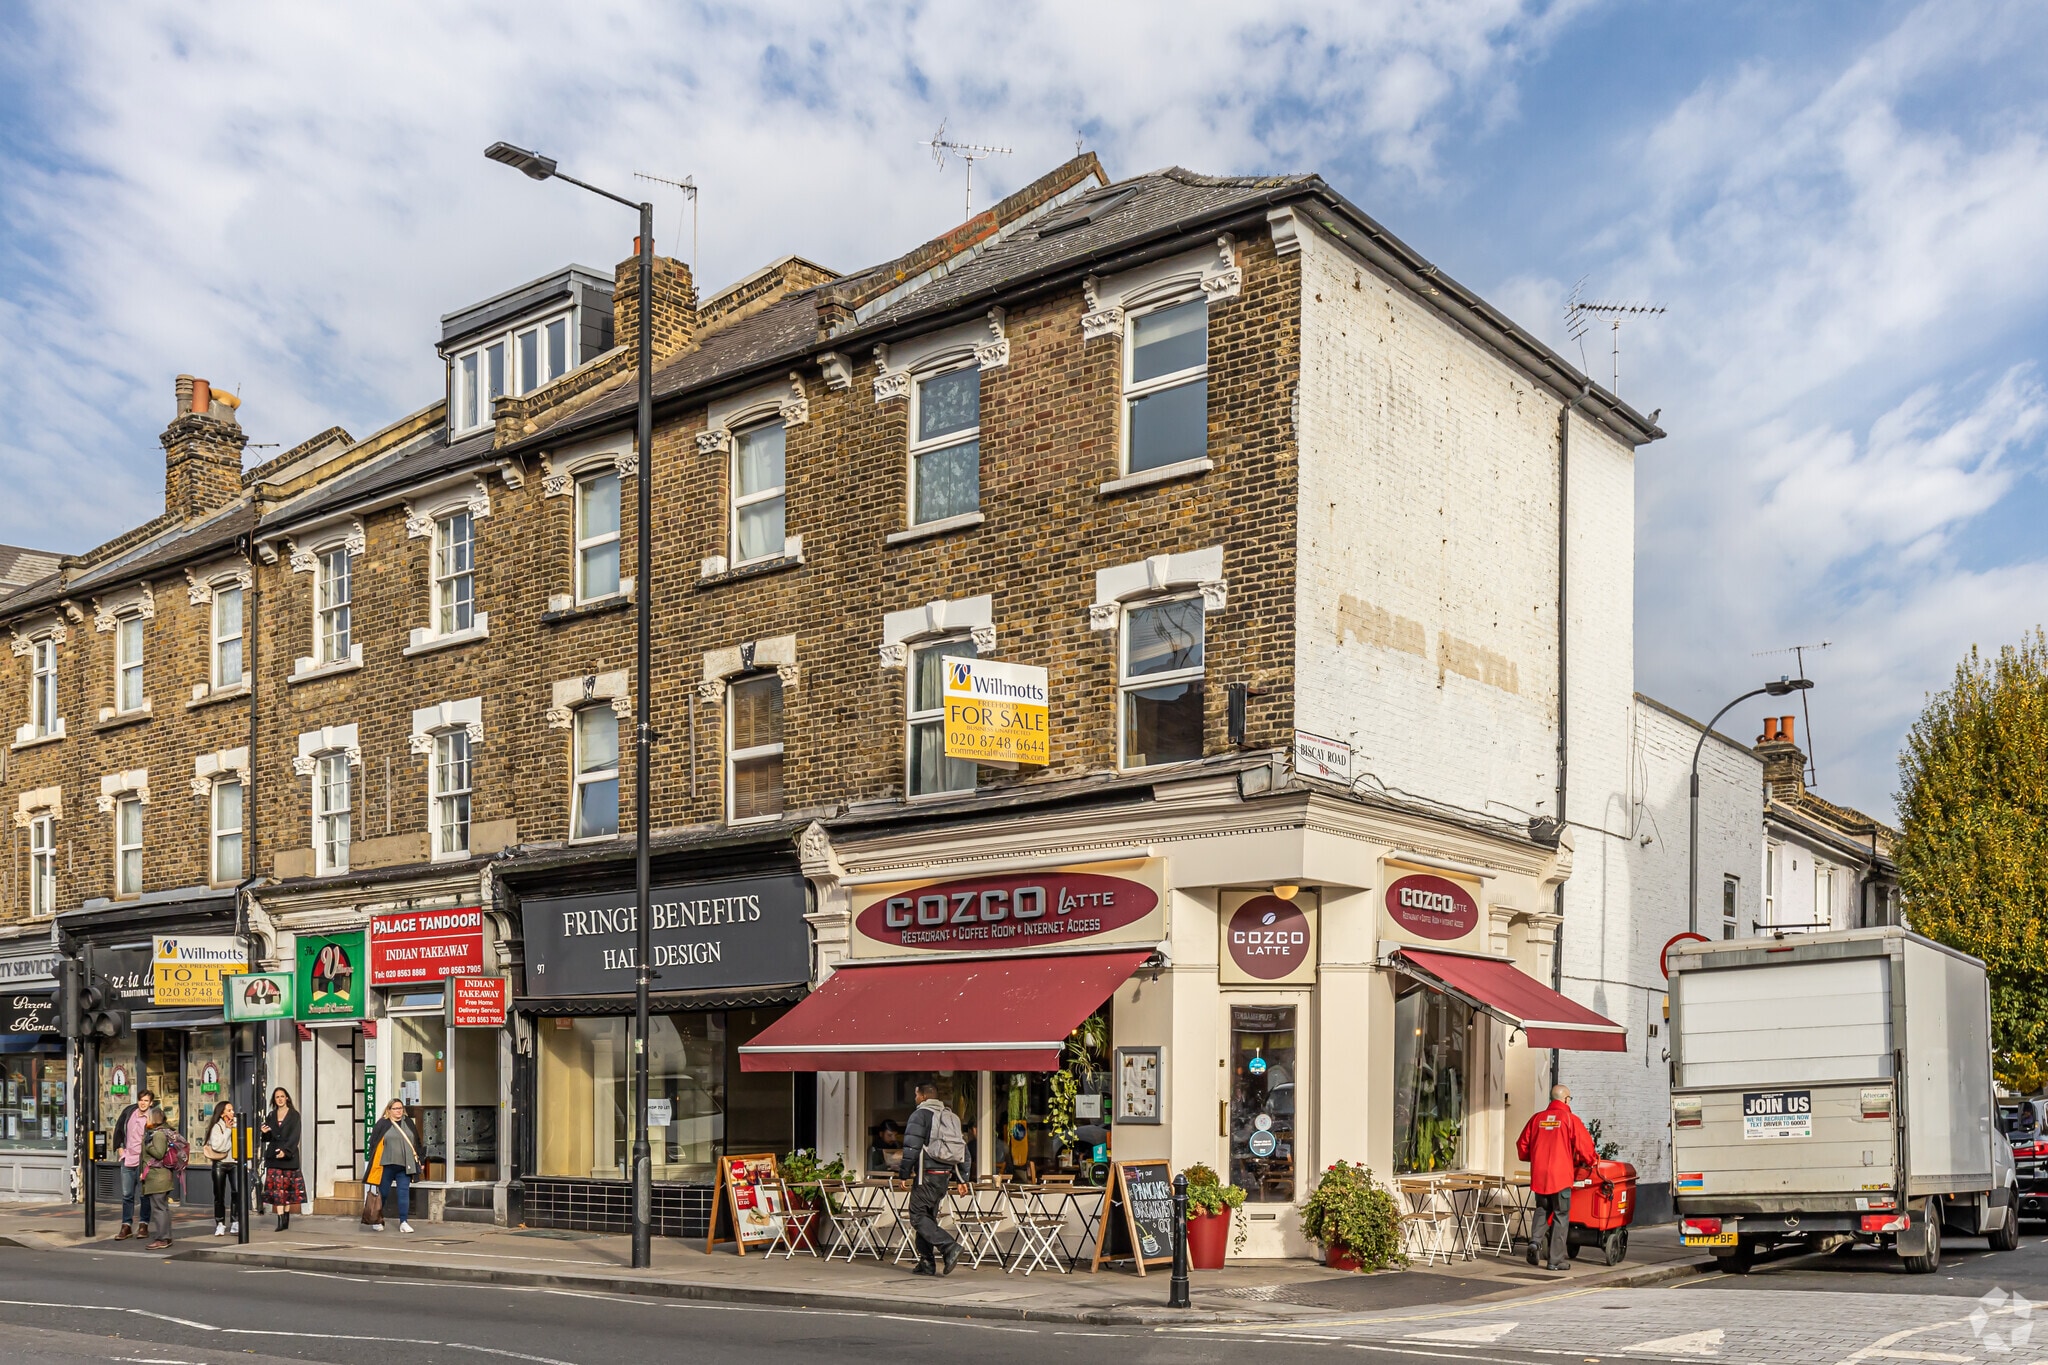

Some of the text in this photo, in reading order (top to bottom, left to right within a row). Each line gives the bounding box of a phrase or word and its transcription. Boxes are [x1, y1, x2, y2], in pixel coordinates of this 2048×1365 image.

[973, 676, 1043, 700] Willmotts
[978, 700, 1018, 710] FREEHOLD
[951, 705, 1044, 731] FOR SALE
[951, 732, 1044, 753] 020 8748 6644
[951, 747, 1045, 762] commercial@willmotts.com
[1300, 744, 1346, 766] BISCAY ROAD
[886, 886, 1046, 928] COZCO
[1401, 887, 1454, 913] COZCO
[652, 895, 760, 930] BENEFITS
[373, 912, 480, 934] PALACE TANDOORI
[1234, 931, 1303, 944] COZCO
[179, 947, 243, 959] Willmotts
[386, 944, 469, 960] INDIAN TAKEAWAY
[654, 941, 721, 967] DESIGN
[1247, 946, 1290, 955] LATTE
[0, 959, 57, 978] TY SERVICES
[160, 969, 192, 981] TO
[374, 971, 384, 979] Tel:
[386, 970, 396, 978] 020
[397, 969, 410, 977] 8563
[438, 967, 449, 975] 020
[450, 966, 465, 974] 8563
[467, 965, 481, 973] 7905
[159, 987, 180, 996] 020
[184, 987, 212, 996] 8748
[464, 980, 494, 988] INDIAN
[458, 990, 499, 998] TAKEAWAY
[13, 996, 52, 1009] Pizzeria
[1746, 1096, 1809, 1114] JOIN US
[1714, 1234, 1733, 1243] PBF
